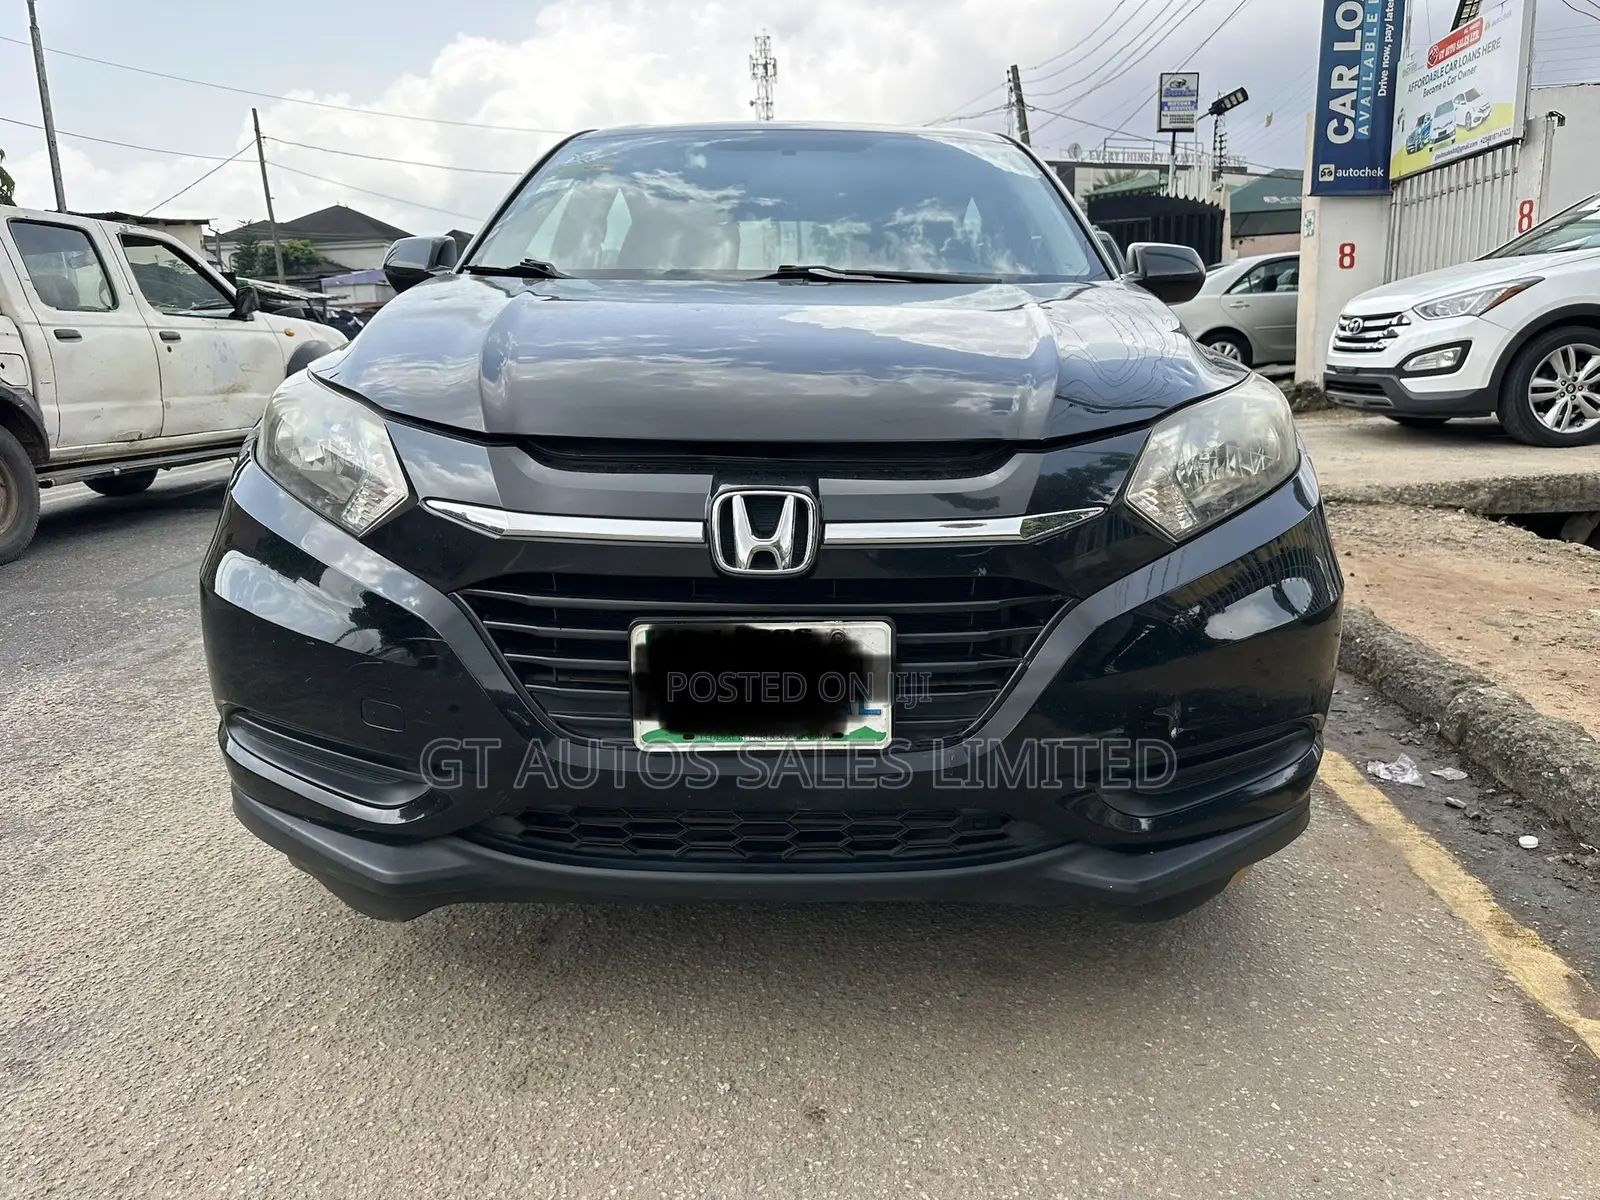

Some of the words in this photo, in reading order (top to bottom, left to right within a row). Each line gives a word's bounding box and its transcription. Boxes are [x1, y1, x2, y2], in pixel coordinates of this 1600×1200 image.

[1333, 0, 1365, 51] LO
[1384, 24, 1394, 43] pay
[1382, 44, 1392, 68] now,
[1408, 67, 1444, 93] AFFORDABLE
[1445, 59, 1458, 75] CAR
[1459, 50, 1480, 67] LOANS
[1481, 37, 1502, 56] HERE
[1358, 13, 1378, 136] AVAILABLE
[1377, 70, 1389, 97] Drive
[1423, 82, 1442, 98] Become
[1447, 75, 1457, 86] Car
[1458, 66, 1477, 80] Owner
[1326, 64, 1360, 144] CAR
[1089, 150, 1150, 163] EVERYTHING
[1336, 166, 1384, 178] autochek
[1518, 199, 1534, 233] 8
[1338, 243, 1356, 269] 8
